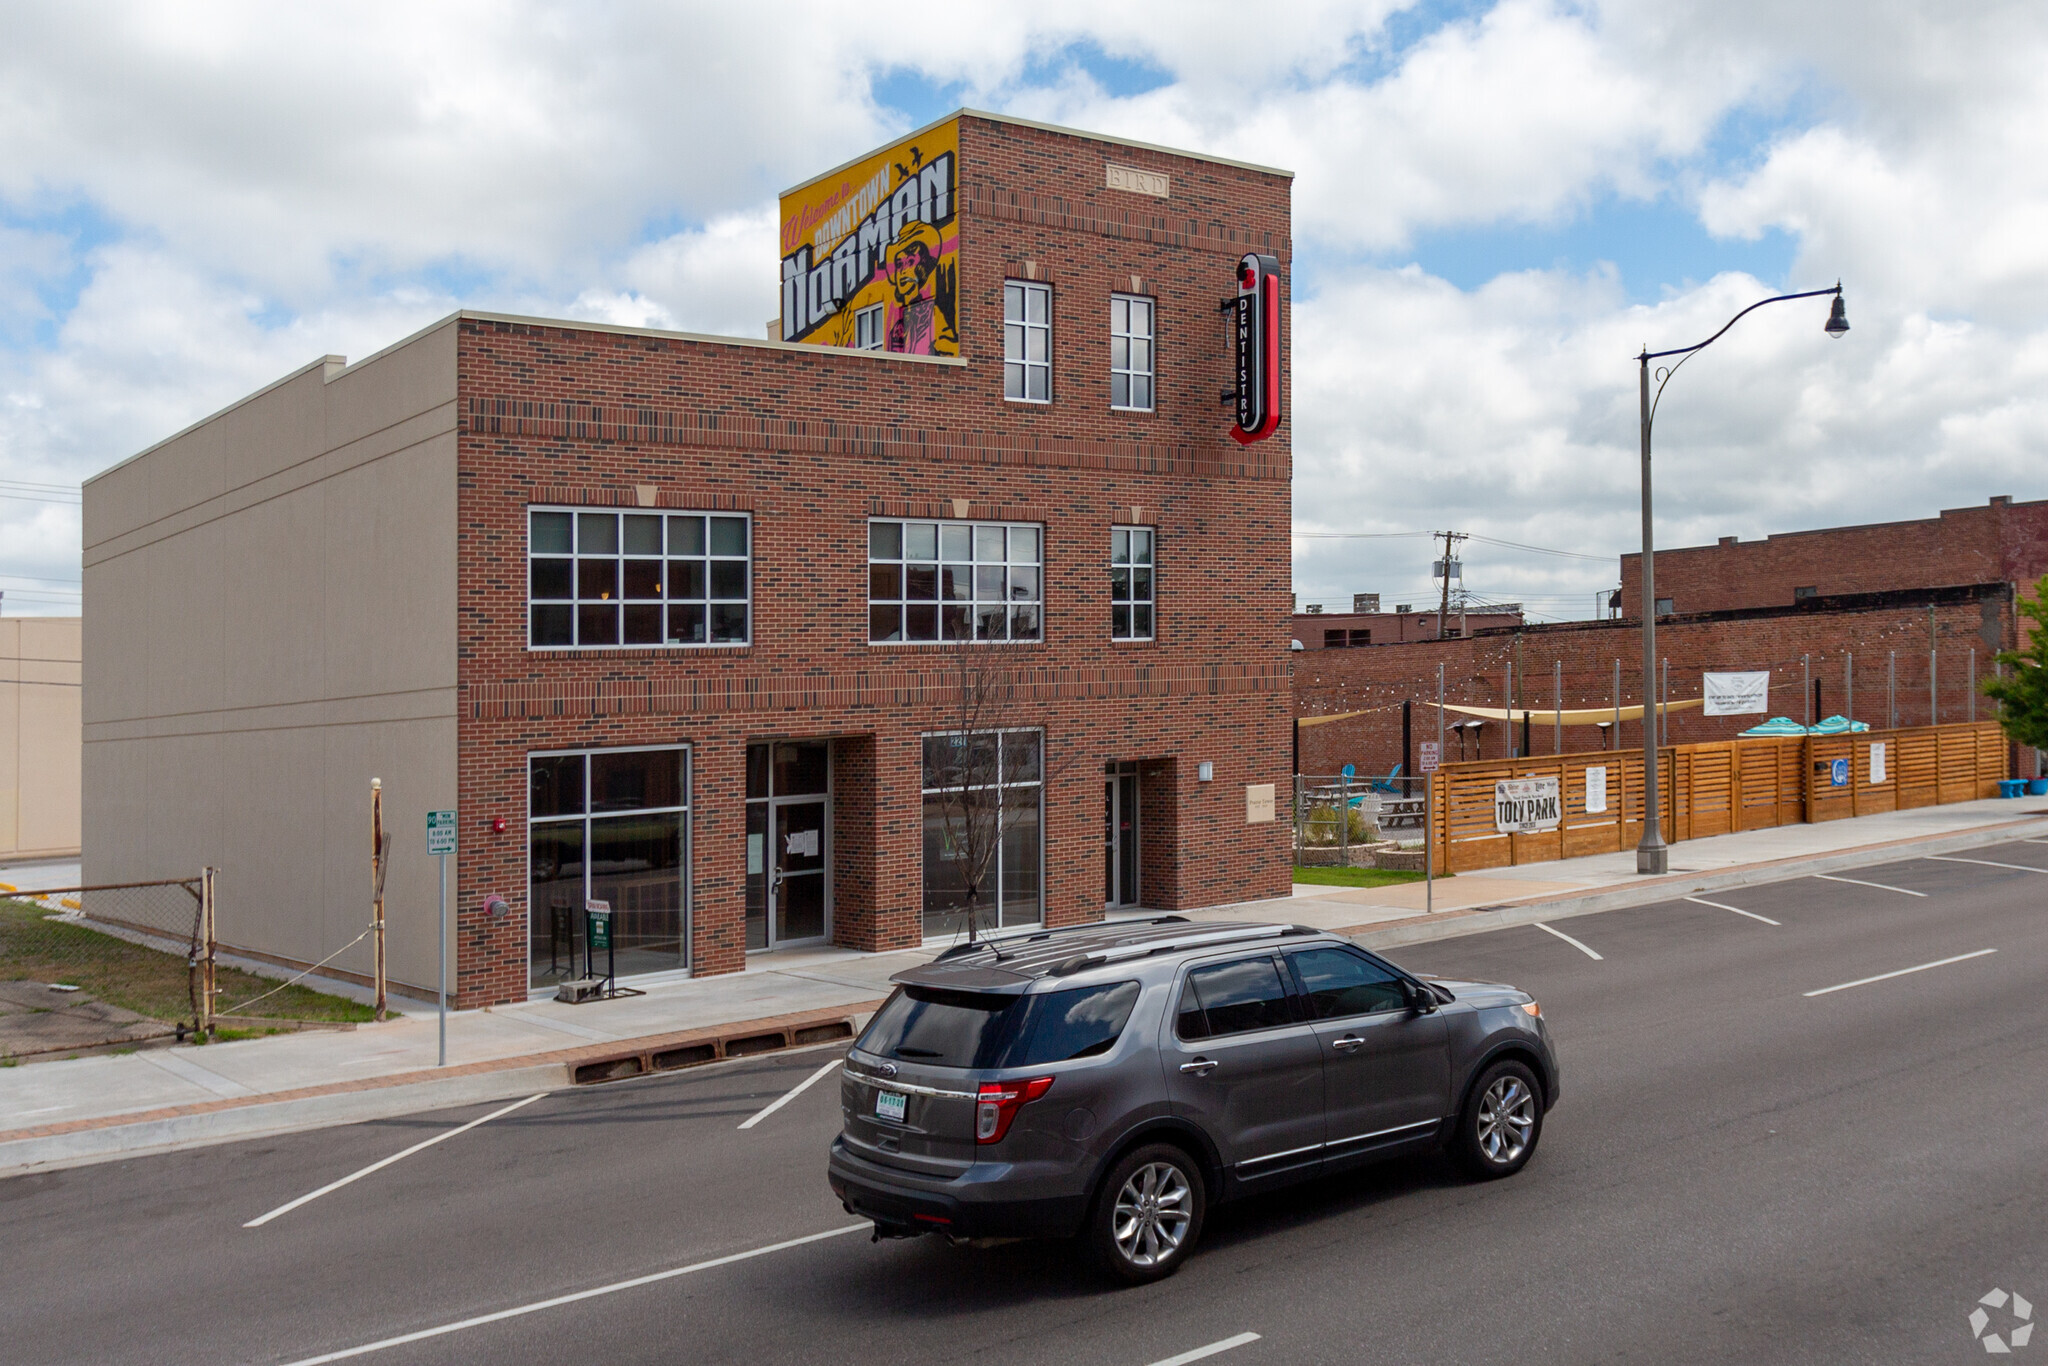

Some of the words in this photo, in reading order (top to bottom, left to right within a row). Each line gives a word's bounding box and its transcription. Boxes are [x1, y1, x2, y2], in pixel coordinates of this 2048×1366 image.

[781, 191, 840, 252] Welcome
[813, 162, 890, 262] DOWNTOWN
[1109, 169, 1164, 194] BIRD
[781, 151, 953, 341] NORMAN
[1239, 299, 1248, 424] DENTISTRY
[1498, 800, 1525, 824] TOLY
[1527, 796, 1558, 822] PARK
